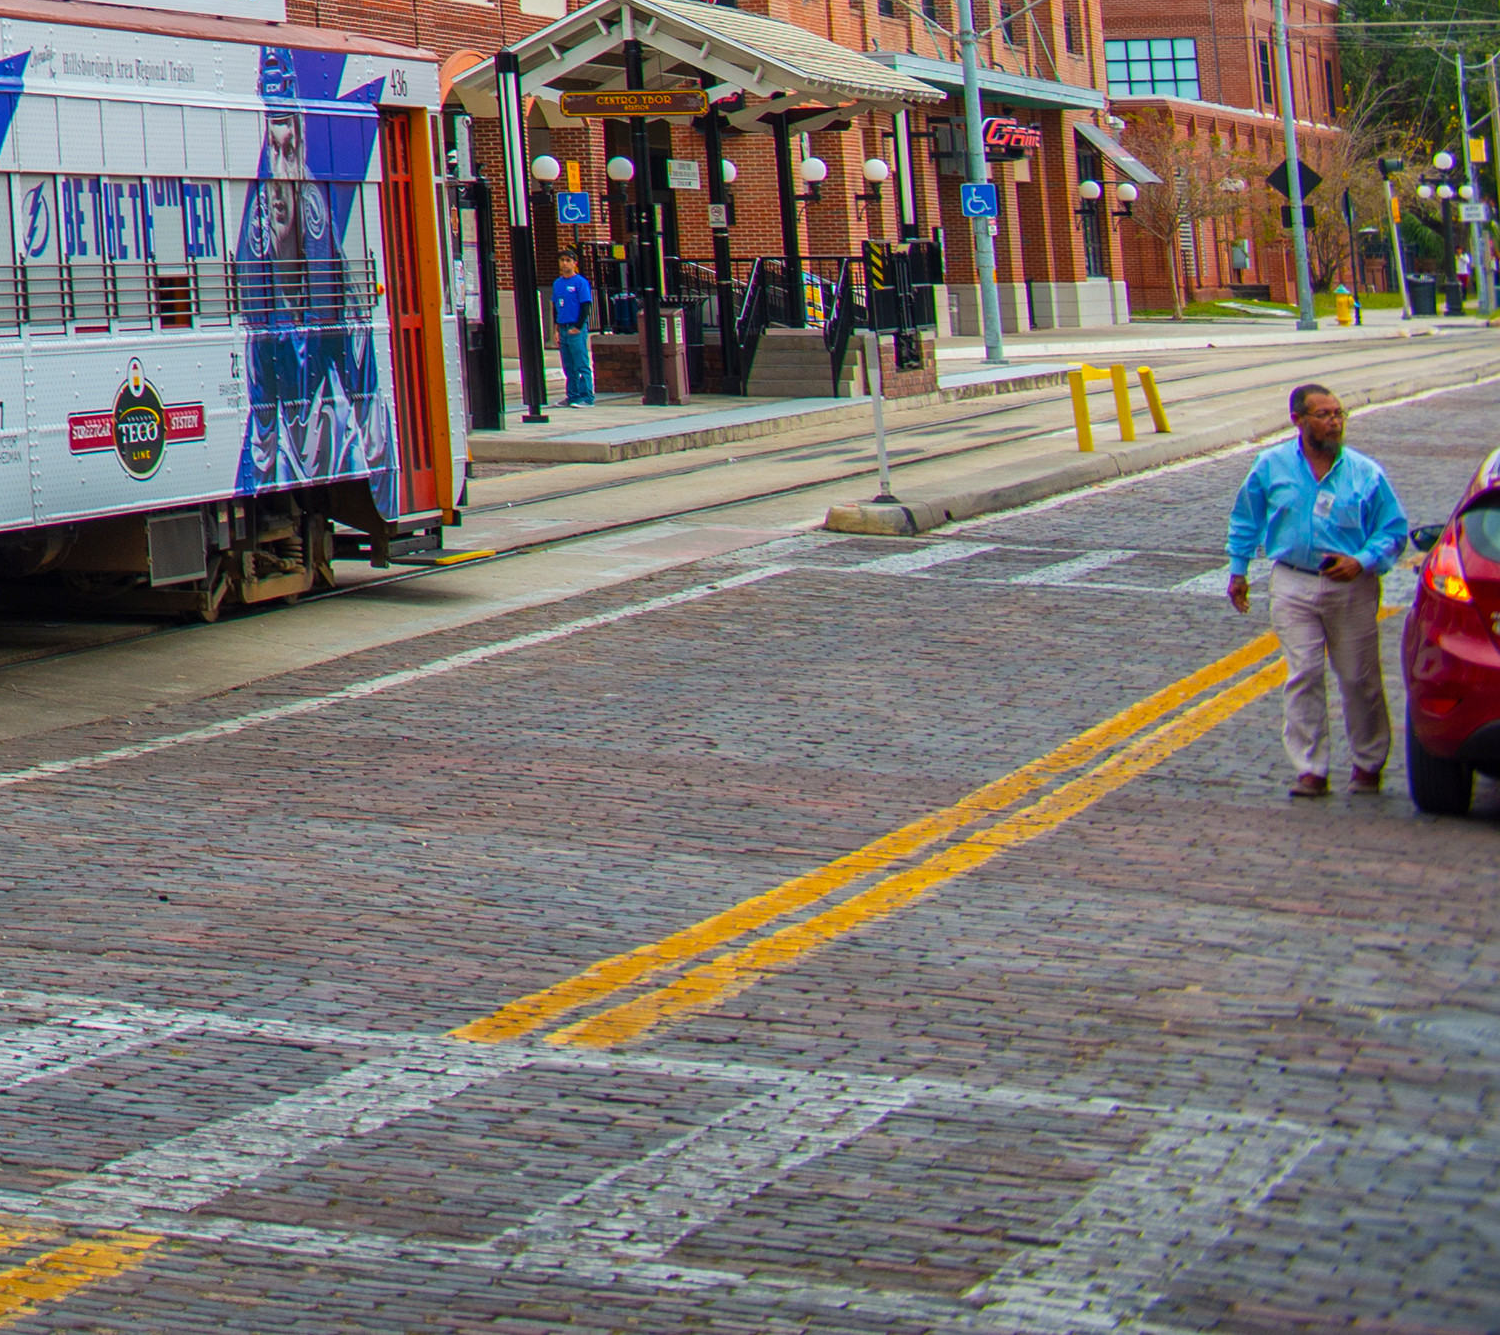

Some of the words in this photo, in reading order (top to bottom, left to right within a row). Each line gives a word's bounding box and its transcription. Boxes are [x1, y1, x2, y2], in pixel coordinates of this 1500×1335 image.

[62, 52, 114, 84] Hillsborough
[116, 58, 134, 80] Area
[134, 58, 167, 86] Regional
[390, 69, 408, 97] 436
[596, 95, 638, 106] CENTRO
[641, 94, 672, 105] YBOR
[62, 178, 88, 257] BE
[117, 420, 159, 444] TECO
[171, 414, 199, 431] SYSTEM
[132, 450, 151, 460] LINE
